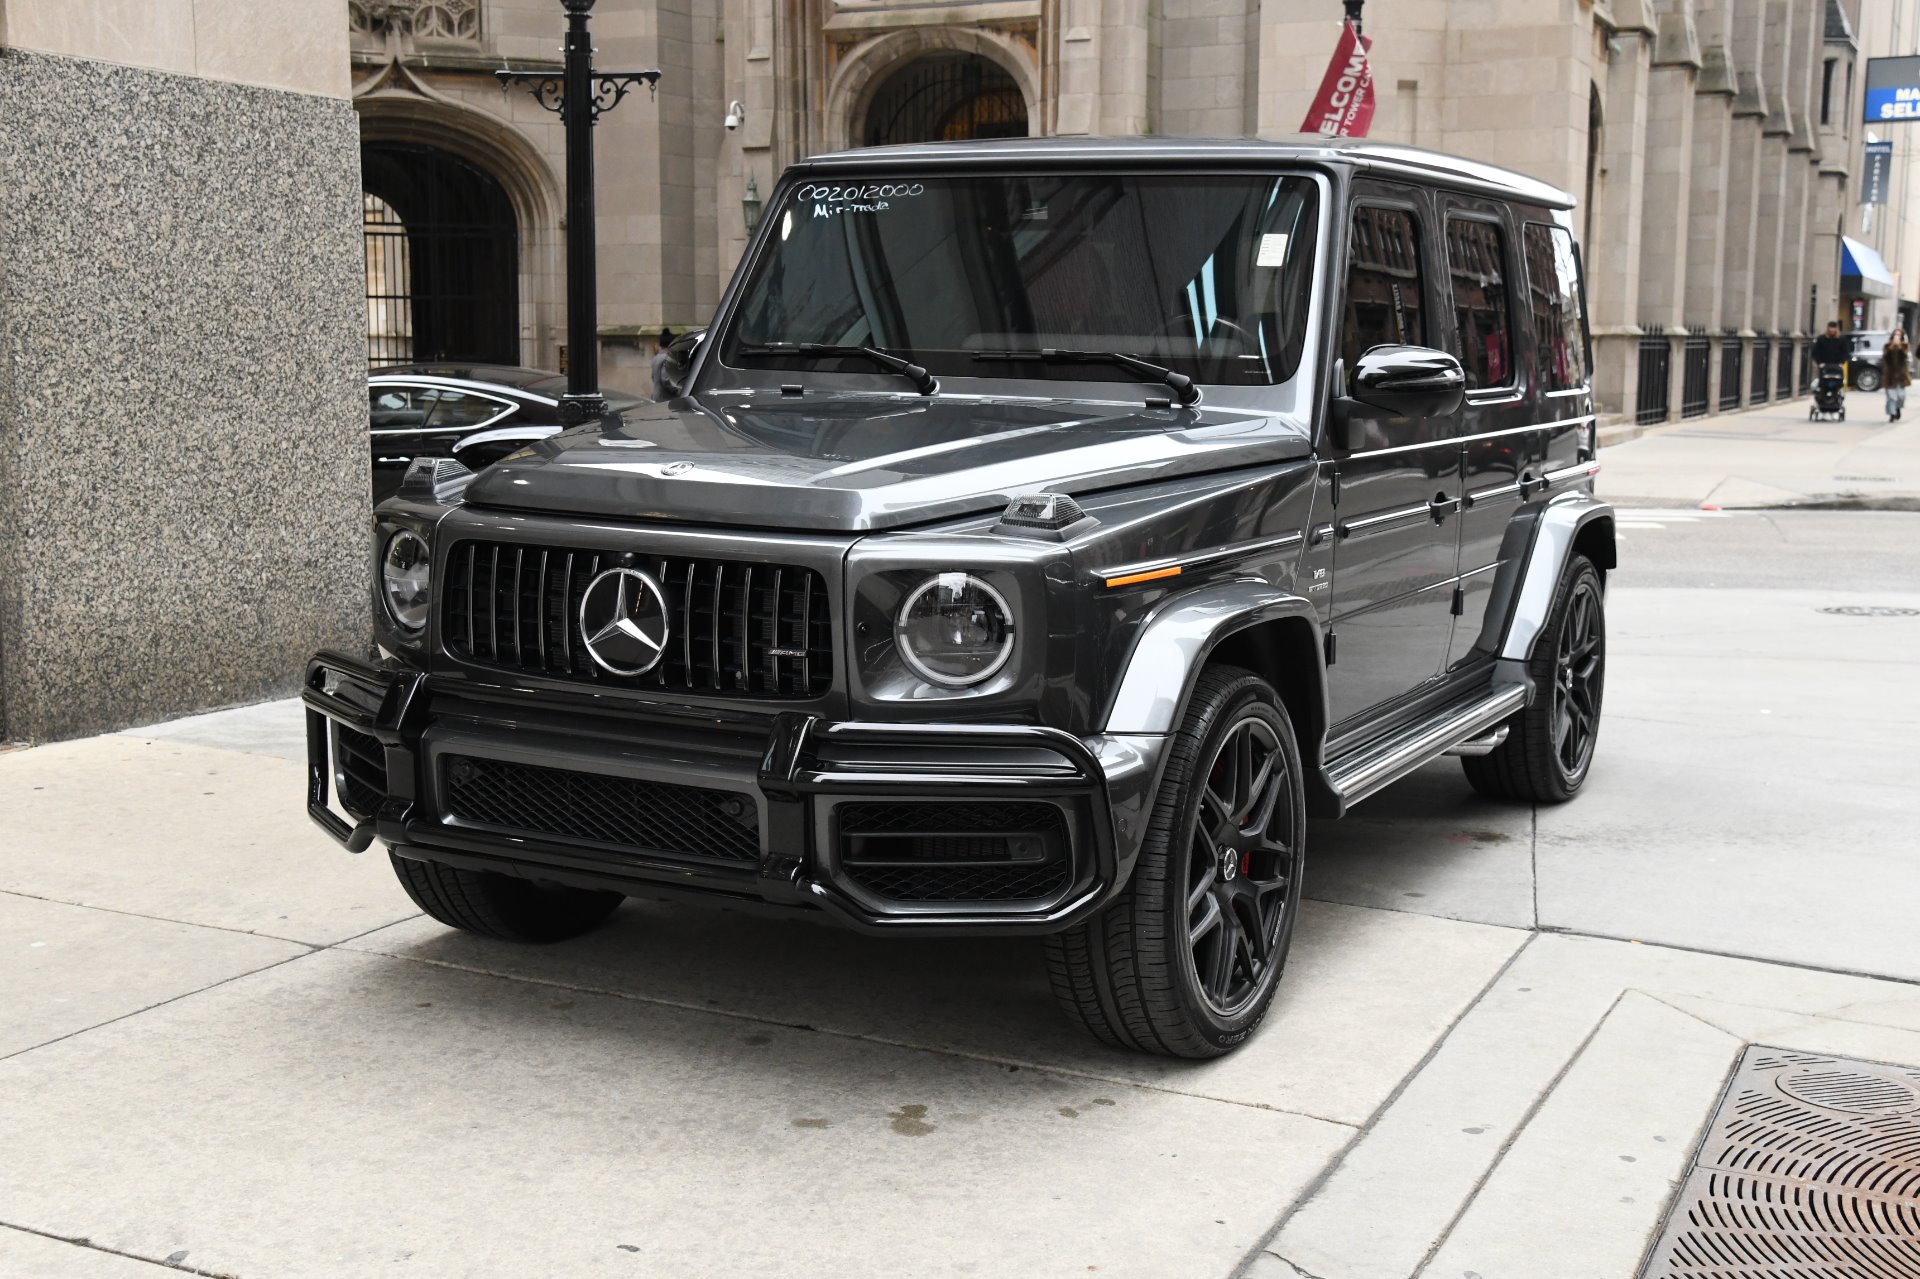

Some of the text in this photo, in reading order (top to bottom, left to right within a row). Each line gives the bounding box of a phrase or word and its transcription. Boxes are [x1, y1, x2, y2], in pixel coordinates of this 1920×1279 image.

[1318, 40, 1366, 136] ELCOM
[1343, 87, 1366, 127] TOWER
[798, 184, 924, 201] 002012000
[778, 649, 806, 657] AMG
[1218, 1031, 1247, 1044] ZERO
